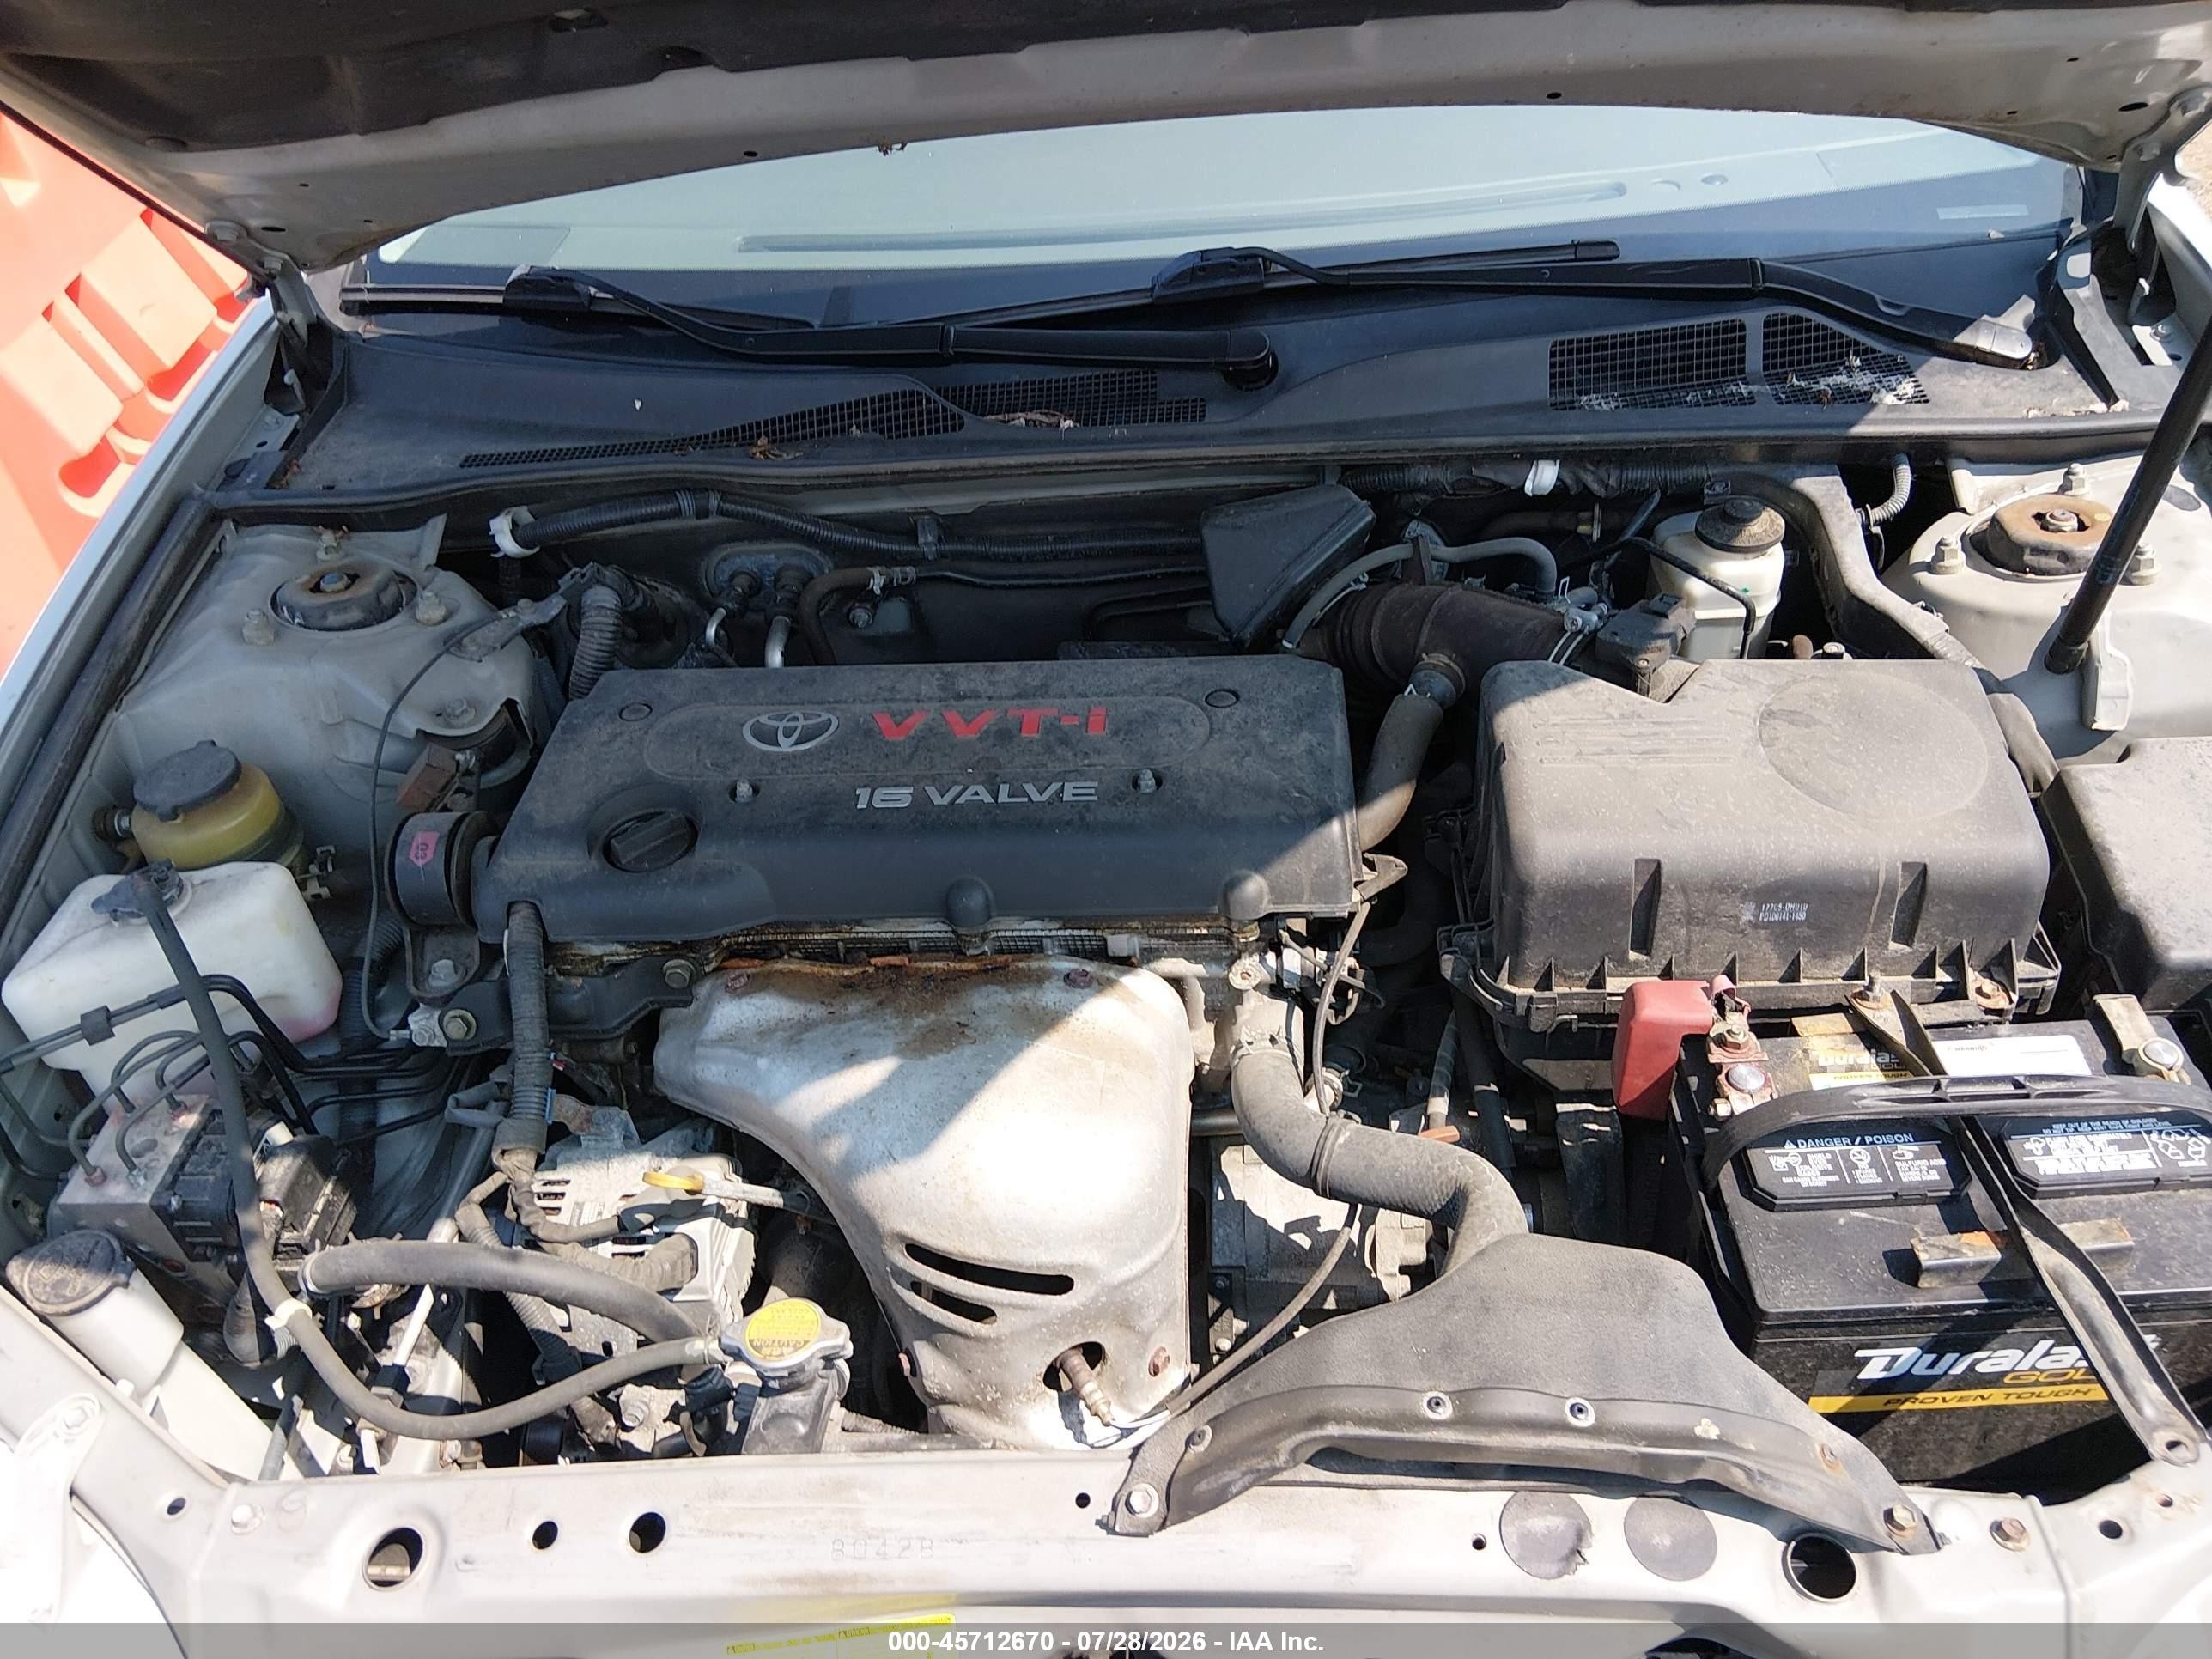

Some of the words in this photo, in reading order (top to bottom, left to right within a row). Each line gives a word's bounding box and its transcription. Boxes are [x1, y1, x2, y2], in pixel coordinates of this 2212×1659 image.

[855, 786, 915, 809] 16
[923, 781, 1099, 805] VALVE
[1812, 1048, 1899, 1066] Durala
[1796, 1138, 1851, 1149] DANGER
[1854, 1136, 1862, 1146] /
[1866, 1133, 1914, 1145] POISON
[753, 1339, 805, 1348] CAUTION
[1854, 1334, 2162, 1379] Durala
[2003, 1367, 2097, 1384] GOL
[1883, 1393, 1992, 1407] PROVEN
[2003, 1388, 2091, 1401] TOUGH
